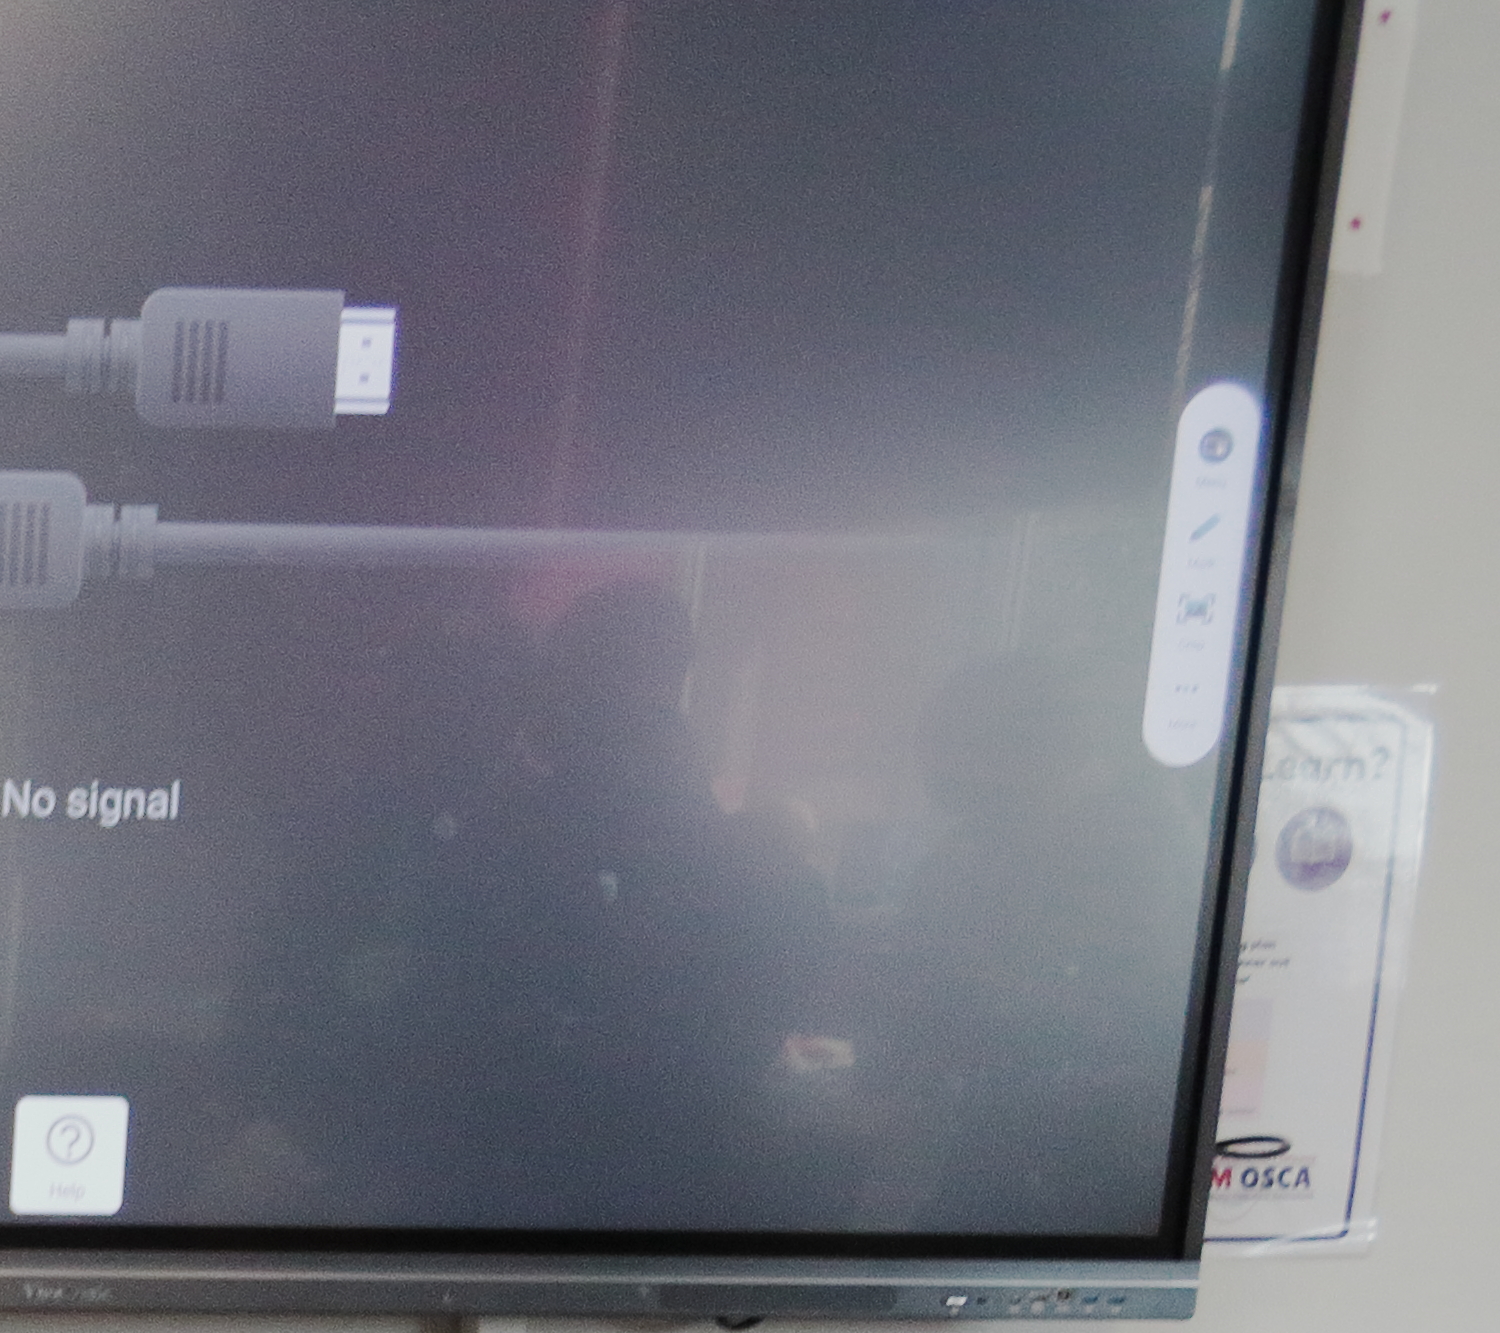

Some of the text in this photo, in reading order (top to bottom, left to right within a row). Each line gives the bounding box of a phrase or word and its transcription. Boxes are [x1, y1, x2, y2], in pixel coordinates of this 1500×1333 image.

[1, 777, 182, 828] No signal
[1240, 1166, 1311, 1189] OSCA
[49, 1182, 87, 1202] Help
